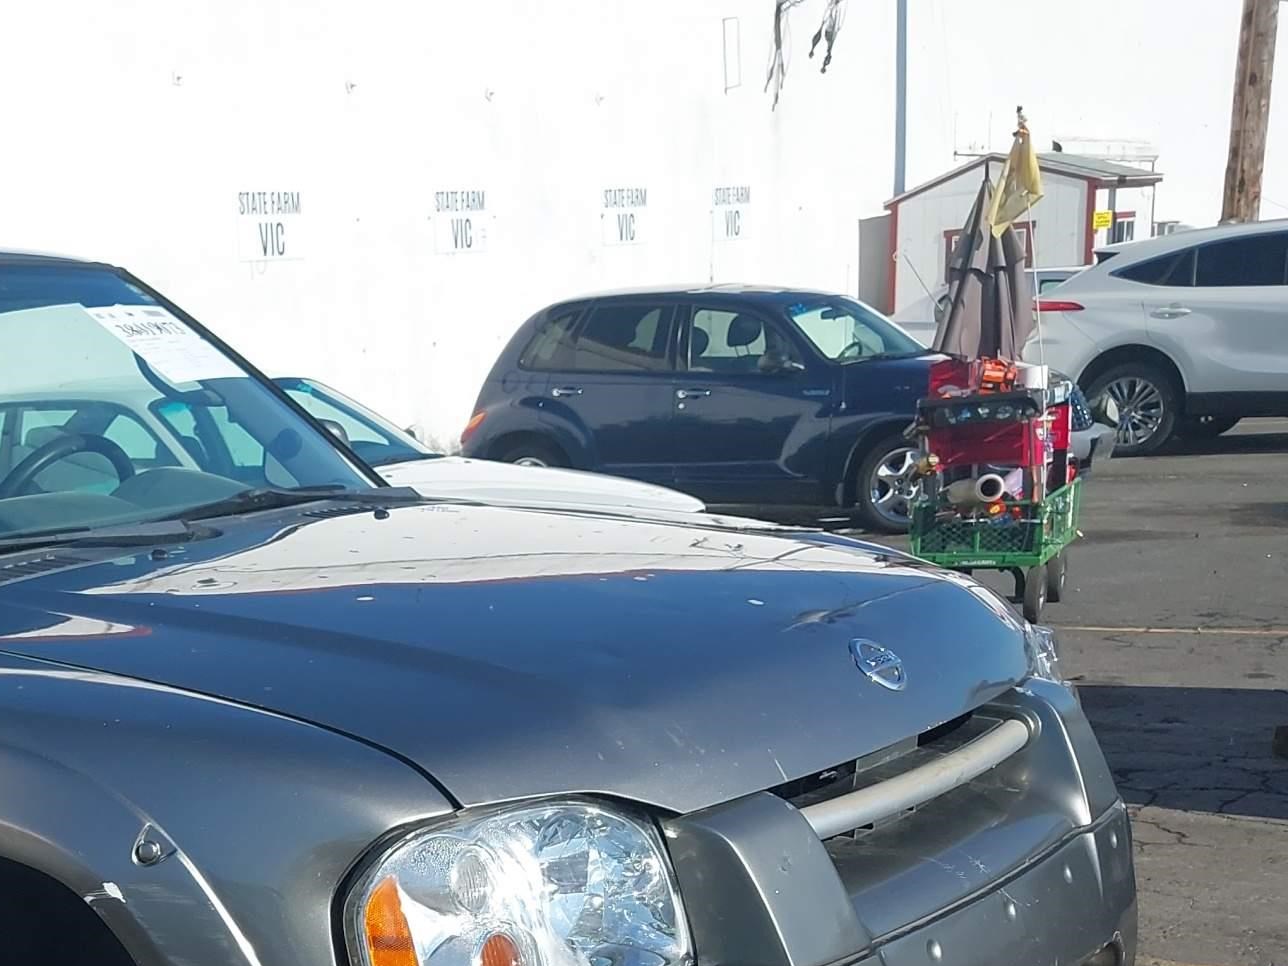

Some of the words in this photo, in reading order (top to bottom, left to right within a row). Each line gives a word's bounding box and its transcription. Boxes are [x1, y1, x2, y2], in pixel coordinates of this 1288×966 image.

[238, 191, 268, 215] STATE
[271, 191, 300, 215] FARM
[435, 190, 459, 212] STATE
[461, 190, 485, 211] FARM
[604, 188, 625, 209] STATE
[627, 188, 647, 208] FARM
[714, 186, 731, 206] STATE
[732, 186, 750, 205] FARM
[451, 217, 473, 248] VIC
[617, 213, 636, 241] VIC
[725, 210, 741, 236] VIC
[258, 221, 286, 256] VIC
